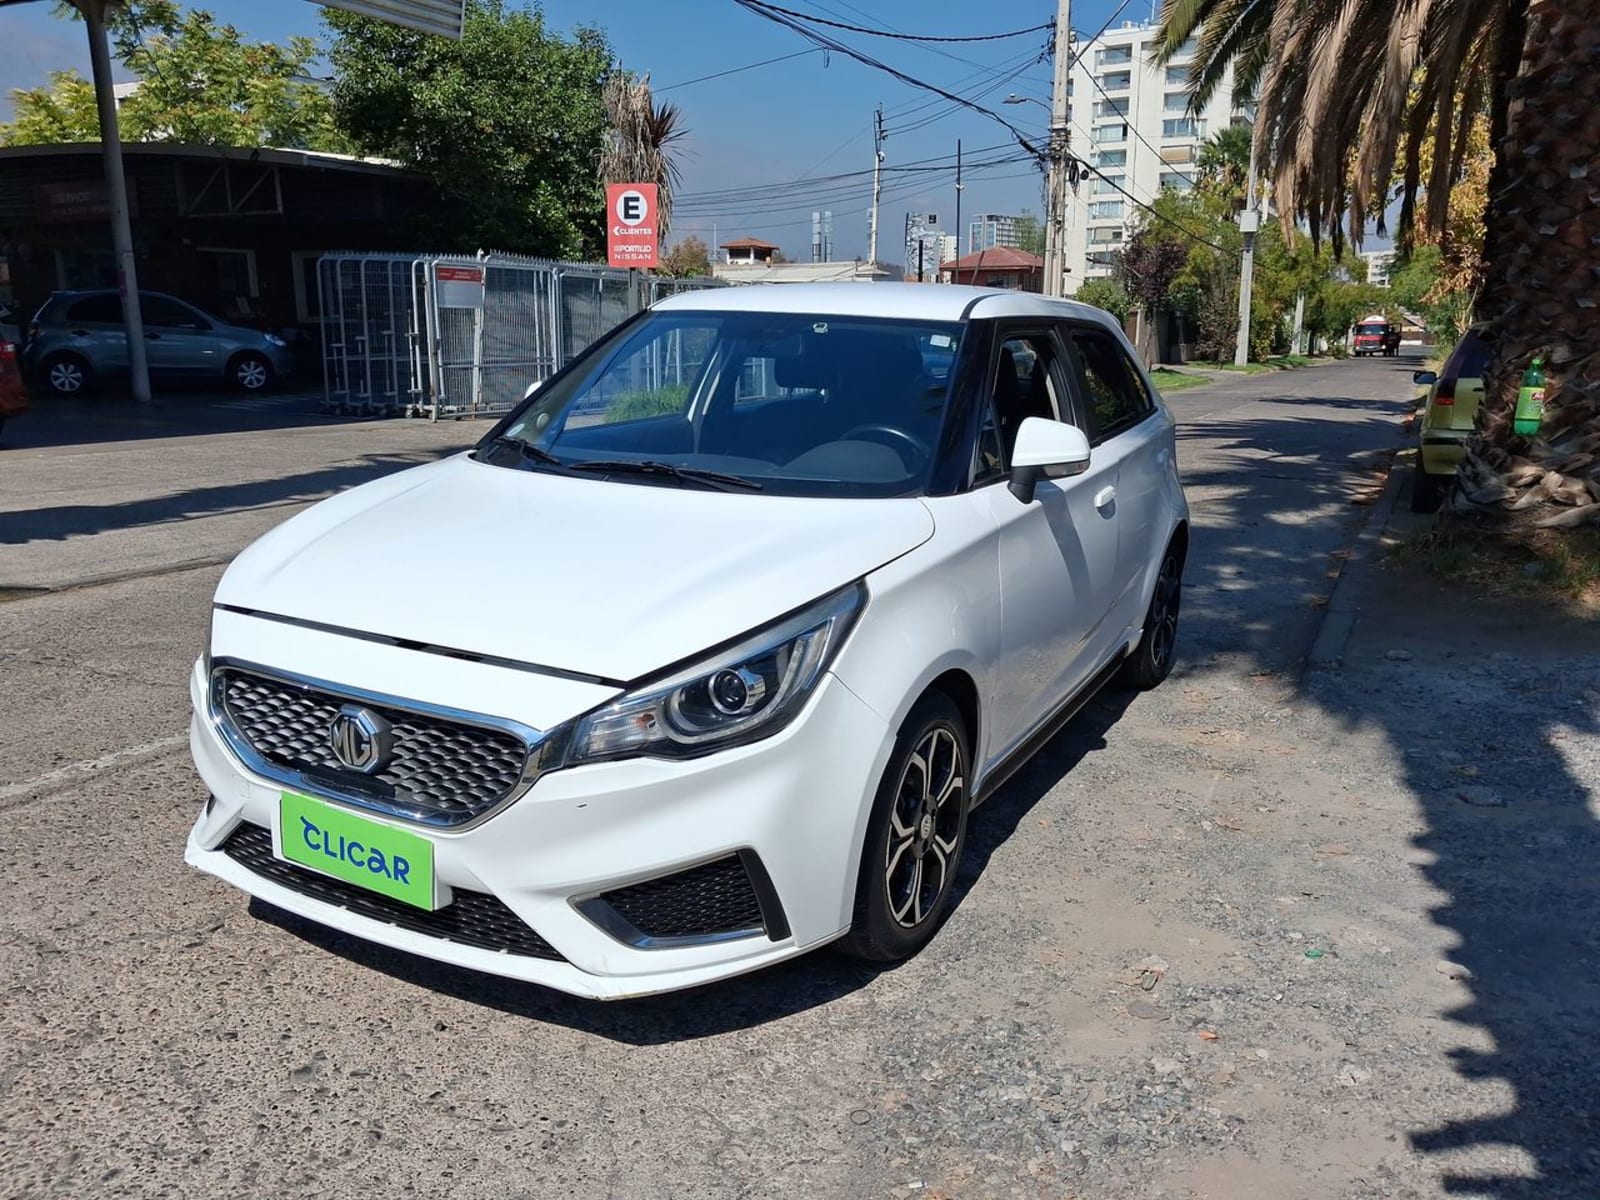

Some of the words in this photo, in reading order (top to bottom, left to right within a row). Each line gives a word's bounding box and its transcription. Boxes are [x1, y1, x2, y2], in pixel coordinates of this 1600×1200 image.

[624, 196, 640, 219] E
[619, 227, 652, 235] CLIENTES
[333, 716, 371, 766] MG
